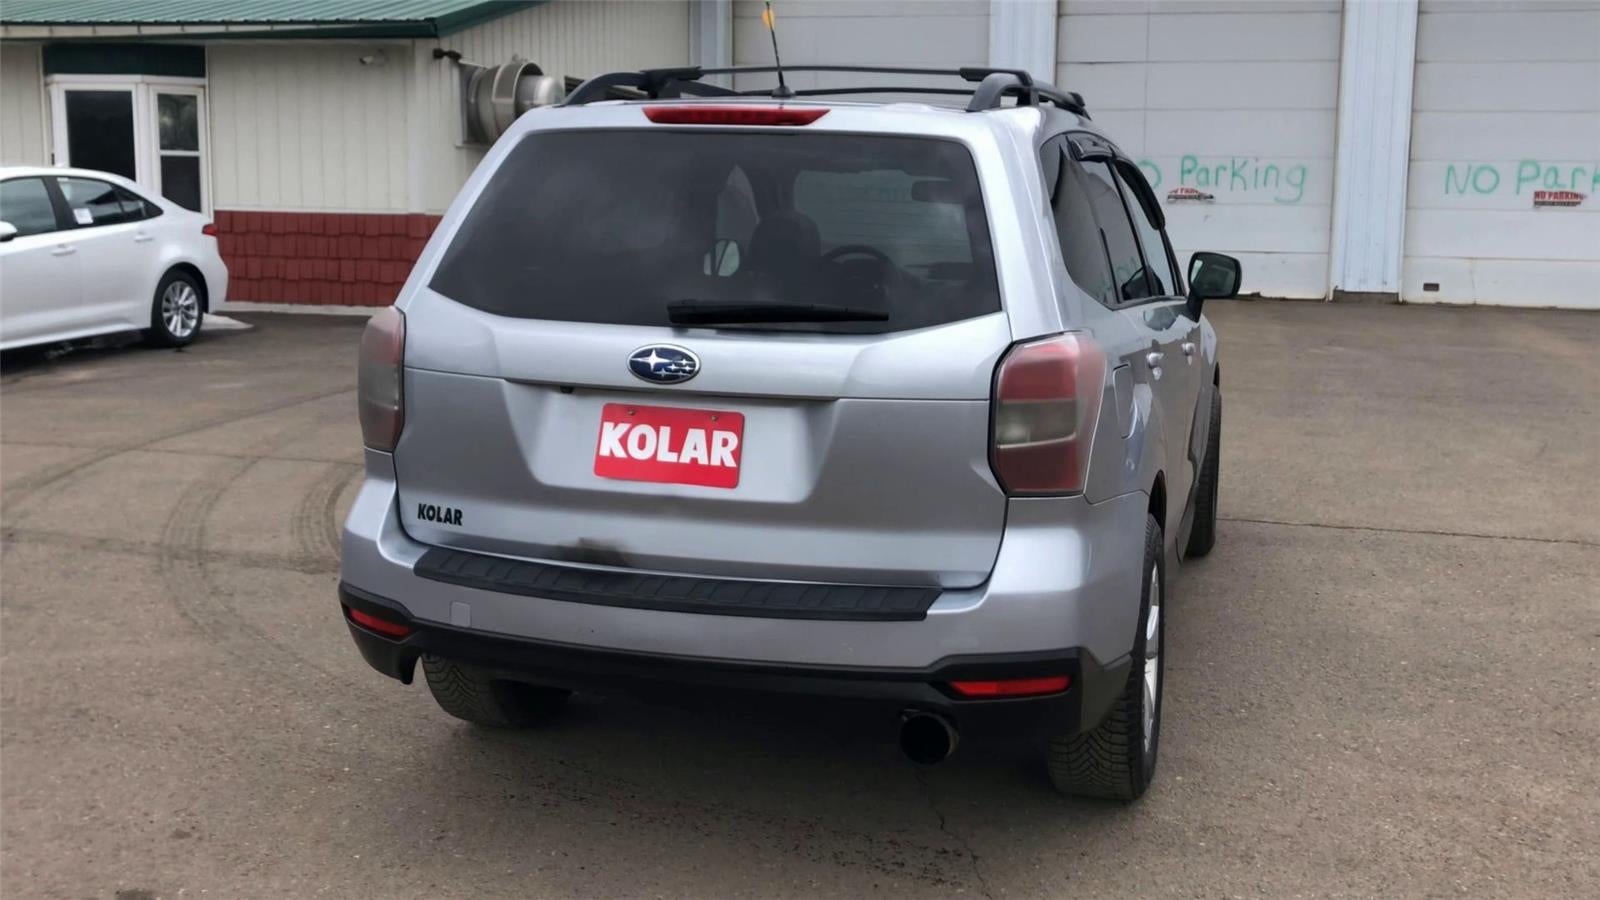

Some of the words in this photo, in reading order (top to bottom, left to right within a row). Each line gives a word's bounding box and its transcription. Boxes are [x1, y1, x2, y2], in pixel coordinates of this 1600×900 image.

[1137, 159, 1162, 190] O
[599, 421, 738, 467] KOLAR
[417, 503, 463, 526] KOLAR
